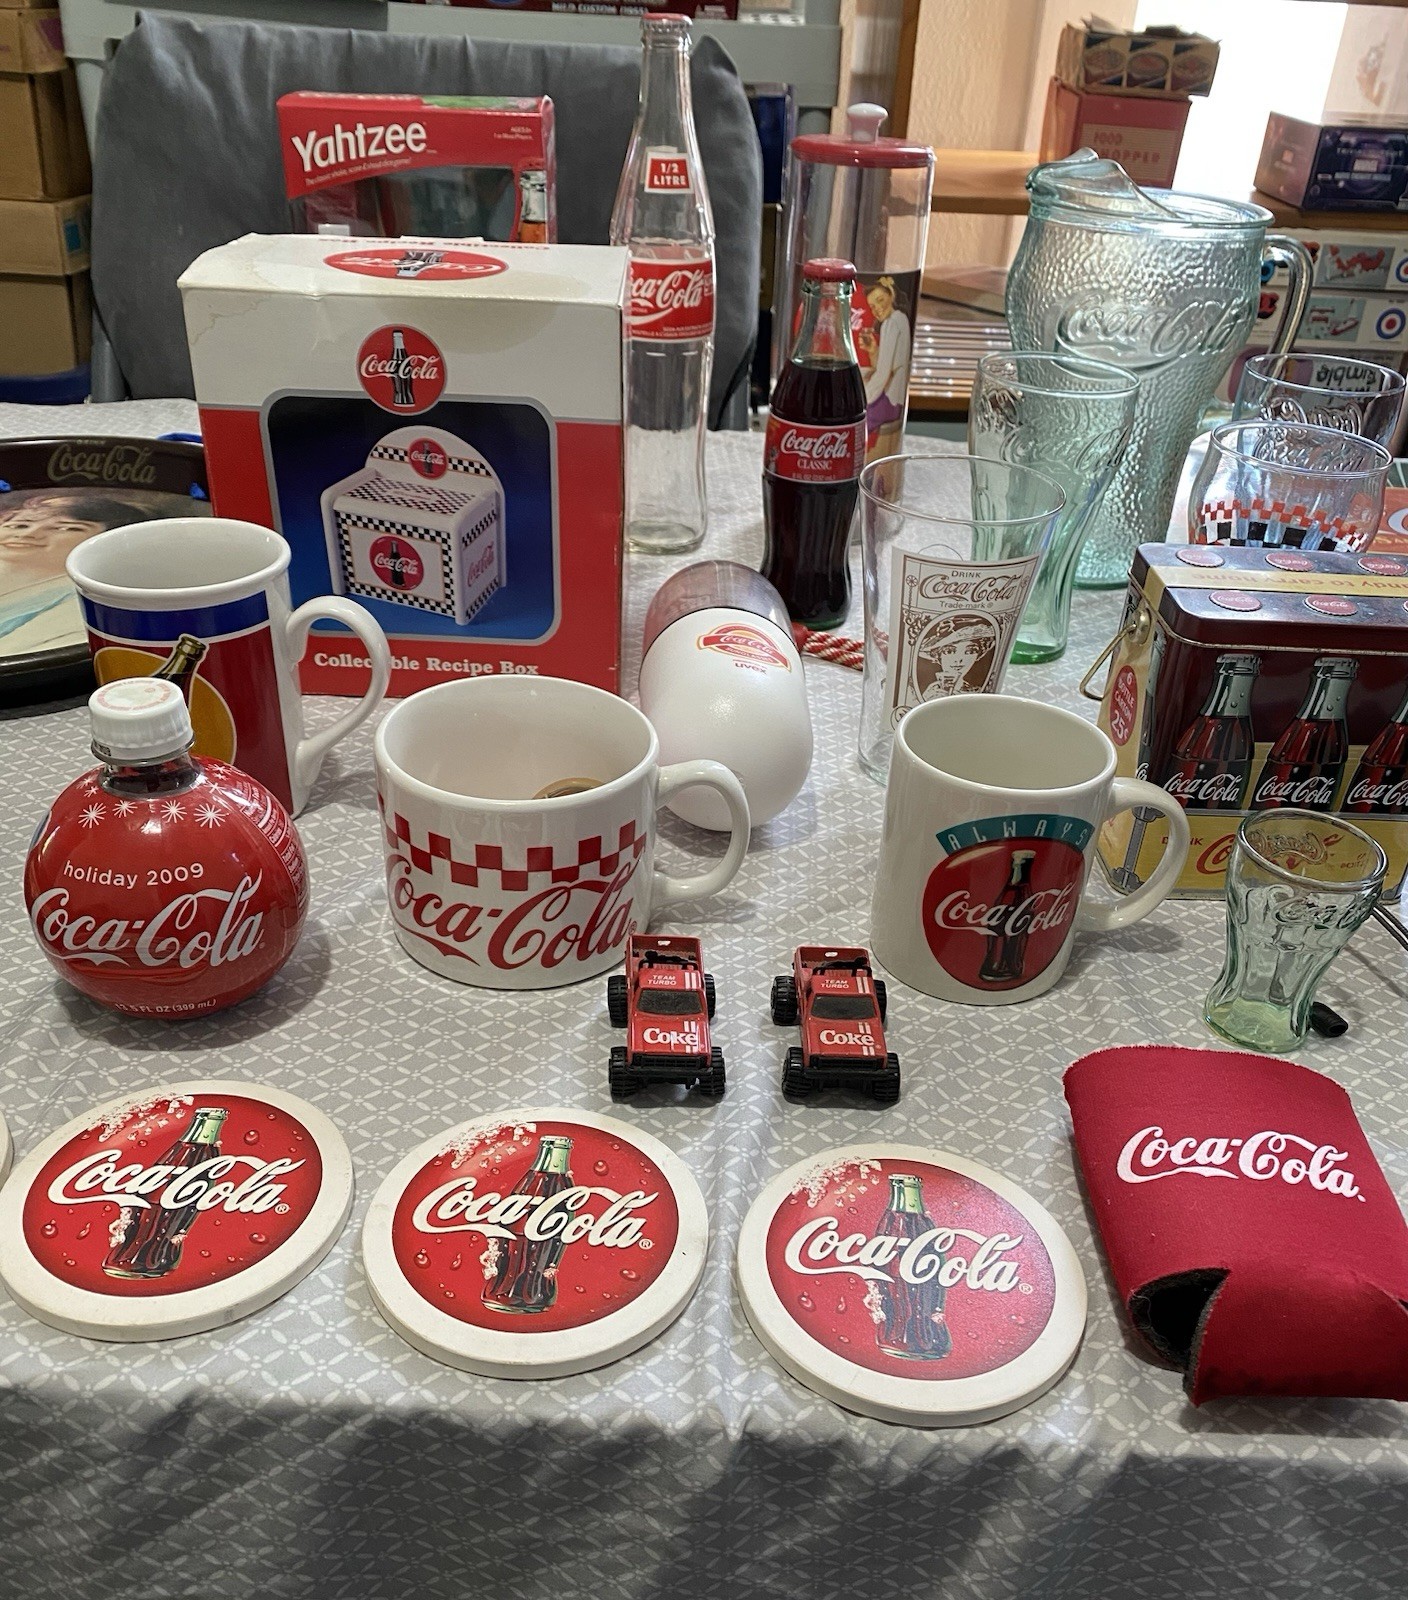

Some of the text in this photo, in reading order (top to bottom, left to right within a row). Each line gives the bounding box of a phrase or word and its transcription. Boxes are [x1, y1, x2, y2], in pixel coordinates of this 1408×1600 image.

[291, 122, 427, 172] Yahtzee
[653, 174, 687, 186] LITRE
[660, 162, 680, 173] 1/2
[630, 269, 704, 309] ca-Cola
[360, 353, 441, 380] Coca-Cola
[780, 428, 850, 459] Coca-Cola
[47, 444, 157, 483] Coca-Cola
[797, 459, 833, 470] CLASSIC
[373, 551, 420, 576] Coca-Cola
[951, 570, 982, 579] DRINK
[919, 573, 1024, 603] Coca-Cola
[1329, 578, 1355, 588] to
[313, 652, 420, 671] Collecble
[426, 657, 494, 677] Recipe
[1126, 671, 1133, 686] 6
[1162, 771, 1243, 801] Coca-Cola
[1255, 775, 1336, 804] Coca-Cola
[1347, 777, 1408, 806] Coca-Co
[947, 819, 1089, 851] ALWAYS
[64, 860, 204, 889] holiday 2009
[31, 868, 263, 969] Coca-Cola
[386, 854, 643, 970] Coca-Cola
[934, 882, 1077, 937] Coca-Cola
[647, 979, 677, 987] TURBO
[155, 1005, 170, 1014] OZ
[643, 1027, 699, 1046] Coke
[819, 1029, 875, 1046] Coke
[1117, 1126, 1366, 1202] Coca-Cola
[47, 1149, 306, 1215] Coca-Cola
[412, 1177, 659, 1249] Coca-Cola
[784, 1215, 1024, 1294] Coca-Cola
